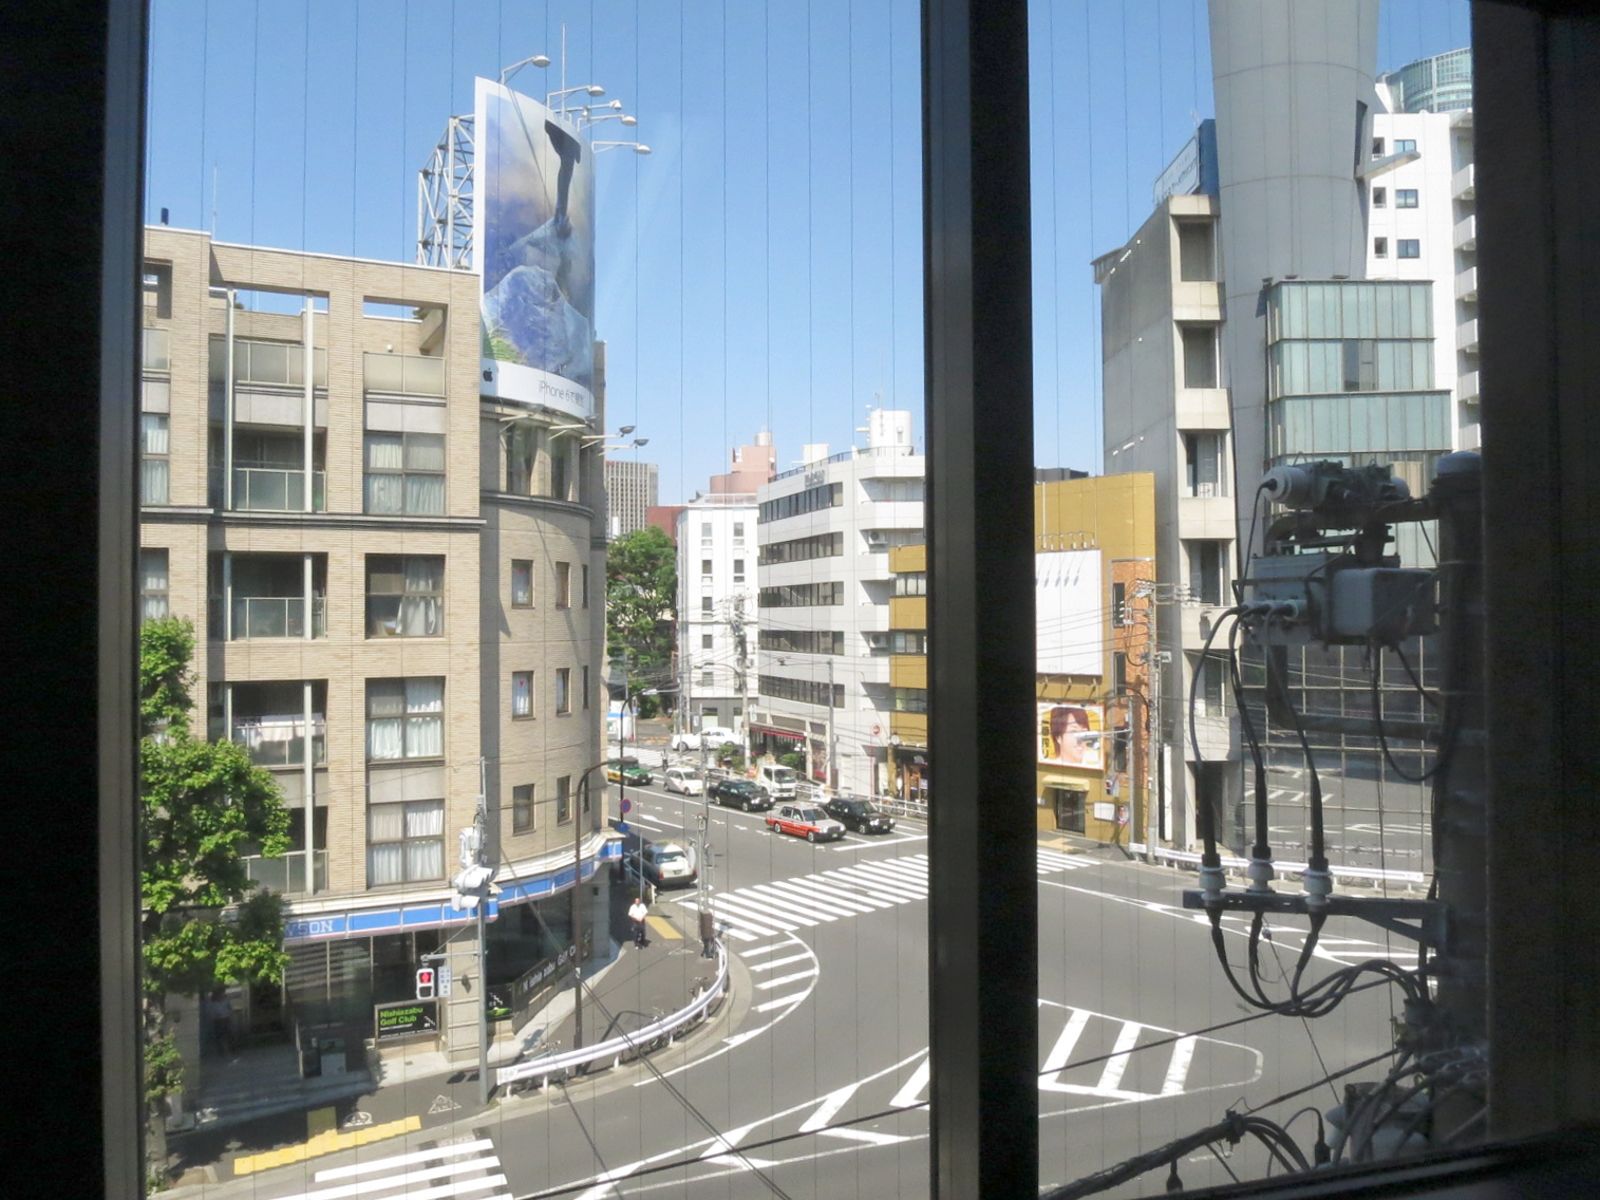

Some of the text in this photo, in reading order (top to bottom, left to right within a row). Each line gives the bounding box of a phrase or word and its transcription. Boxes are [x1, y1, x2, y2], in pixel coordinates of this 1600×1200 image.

[537, 379, 564, 399] iPhone
[380, 1007, 424, 1018] Nishiazabu
[380, 1015, 417, 1026] Golf Club
